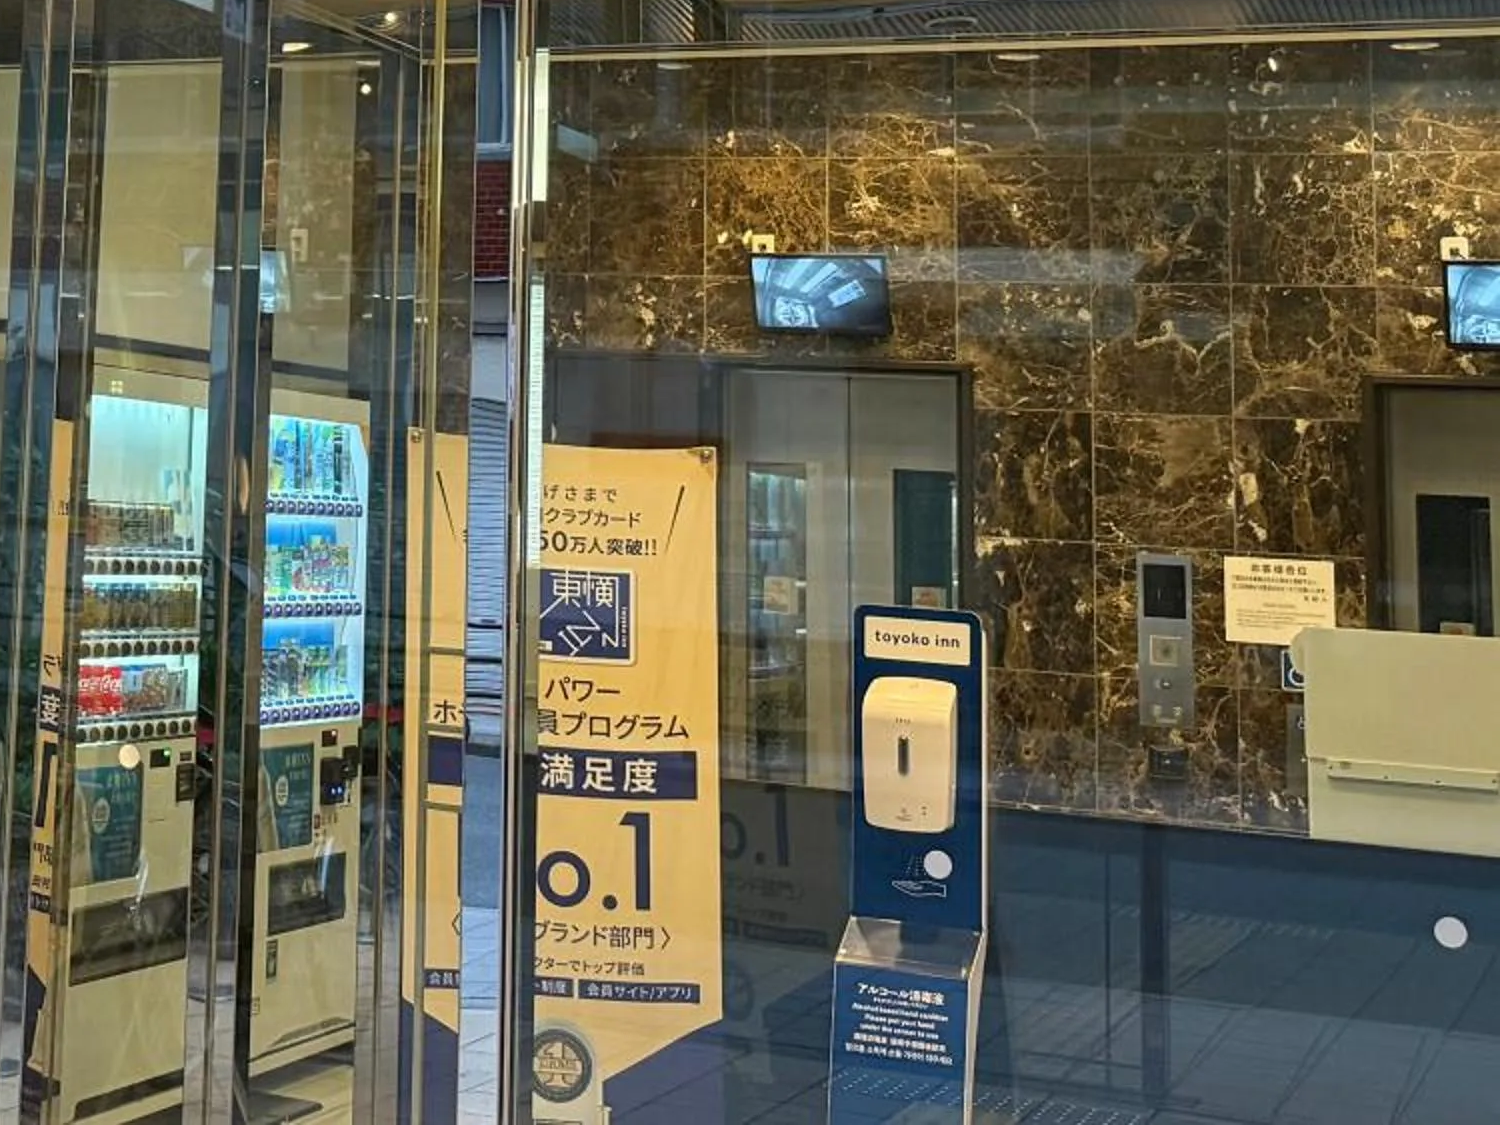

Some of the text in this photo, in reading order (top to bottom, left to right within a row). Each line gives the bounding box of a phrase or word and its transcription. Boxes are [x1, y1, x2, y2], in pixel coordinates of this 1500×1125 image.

[540, 507, 642, 529] クラブカード
[875, 630, 961, 648] toyoko inn
[545, 677, 621, 702] パワー
[433, 700, 466, 724] ホ
[540, 752, 659, 794] 満足度
[537, 811, 651, 911] o.1
